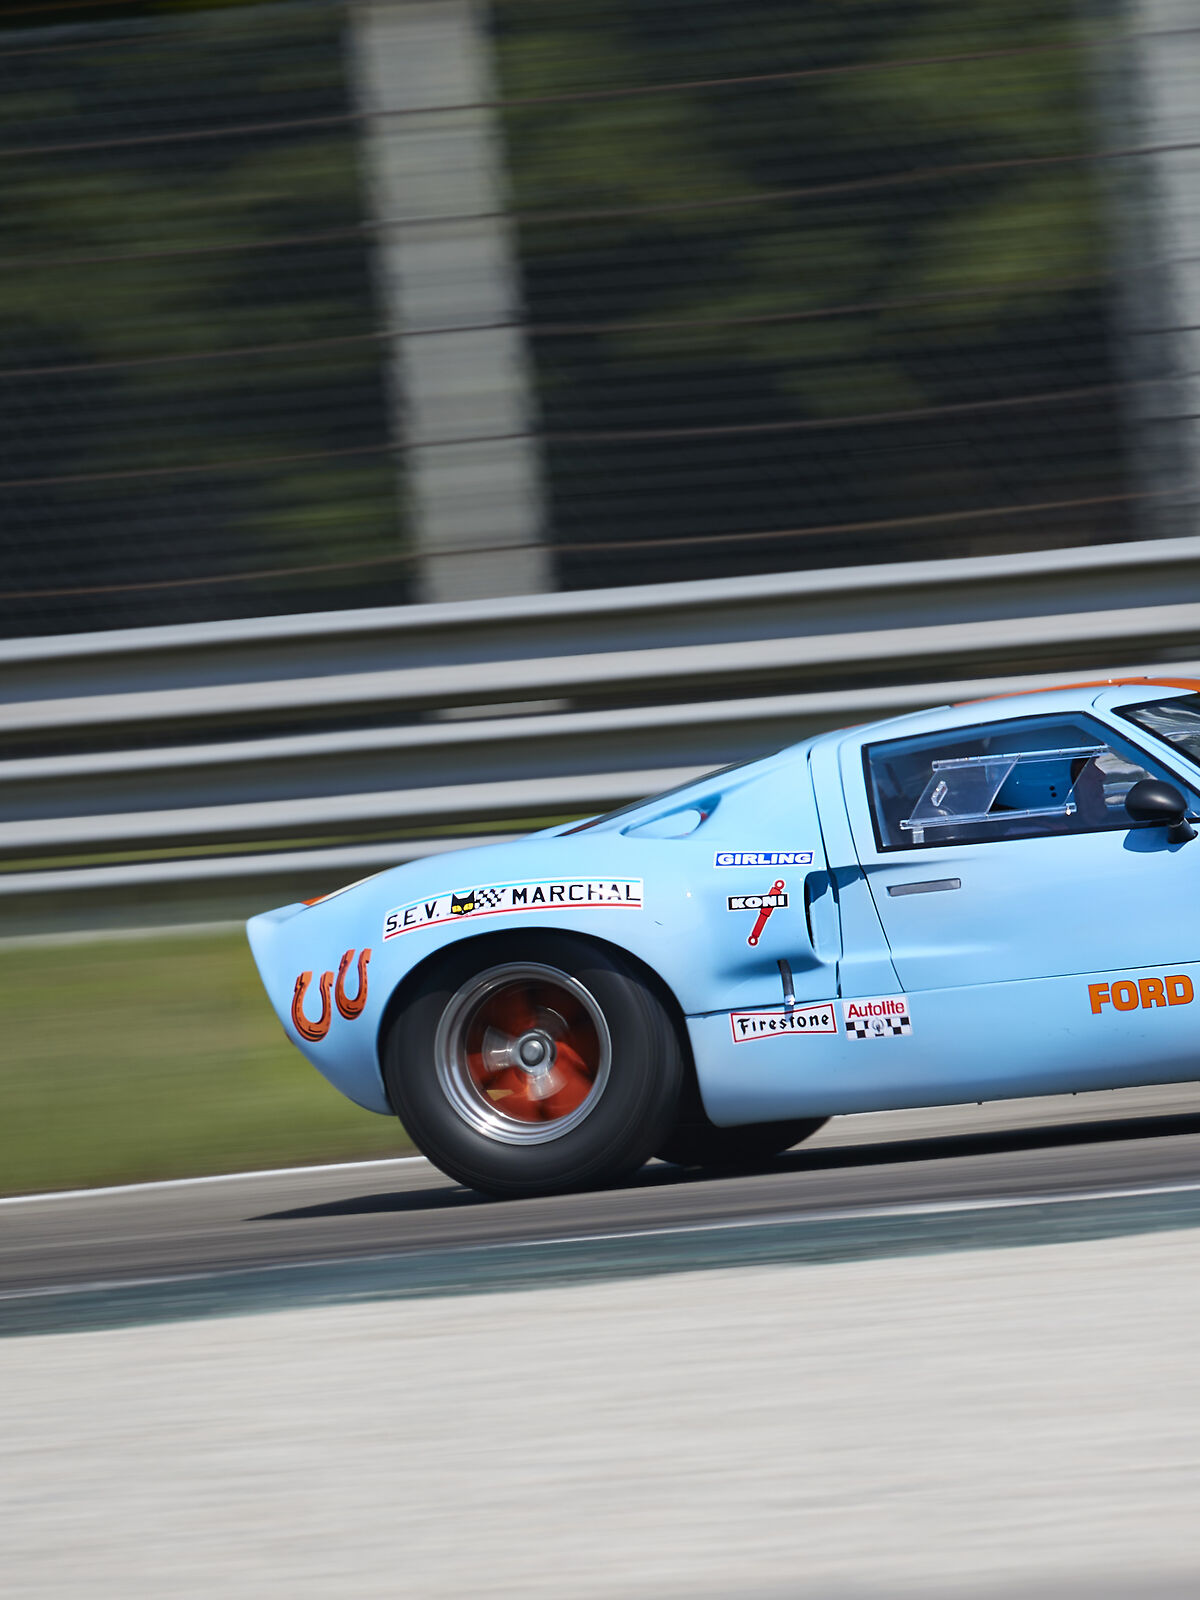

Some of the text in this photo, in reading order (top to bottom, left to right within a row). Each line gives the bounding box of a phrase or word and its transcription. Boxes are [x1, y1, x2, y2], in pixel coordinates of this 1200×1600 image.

[717, 852, 811, 866] GIRLING
[731, 894, 785, 909] KONI
[386, 901, 440, 932] S.E.V.
[1088, 975, 1194, 1014] FORD
[848, 1001, 905, 1018] Autolite
[737, 1013, 830, 1035] Firestone
